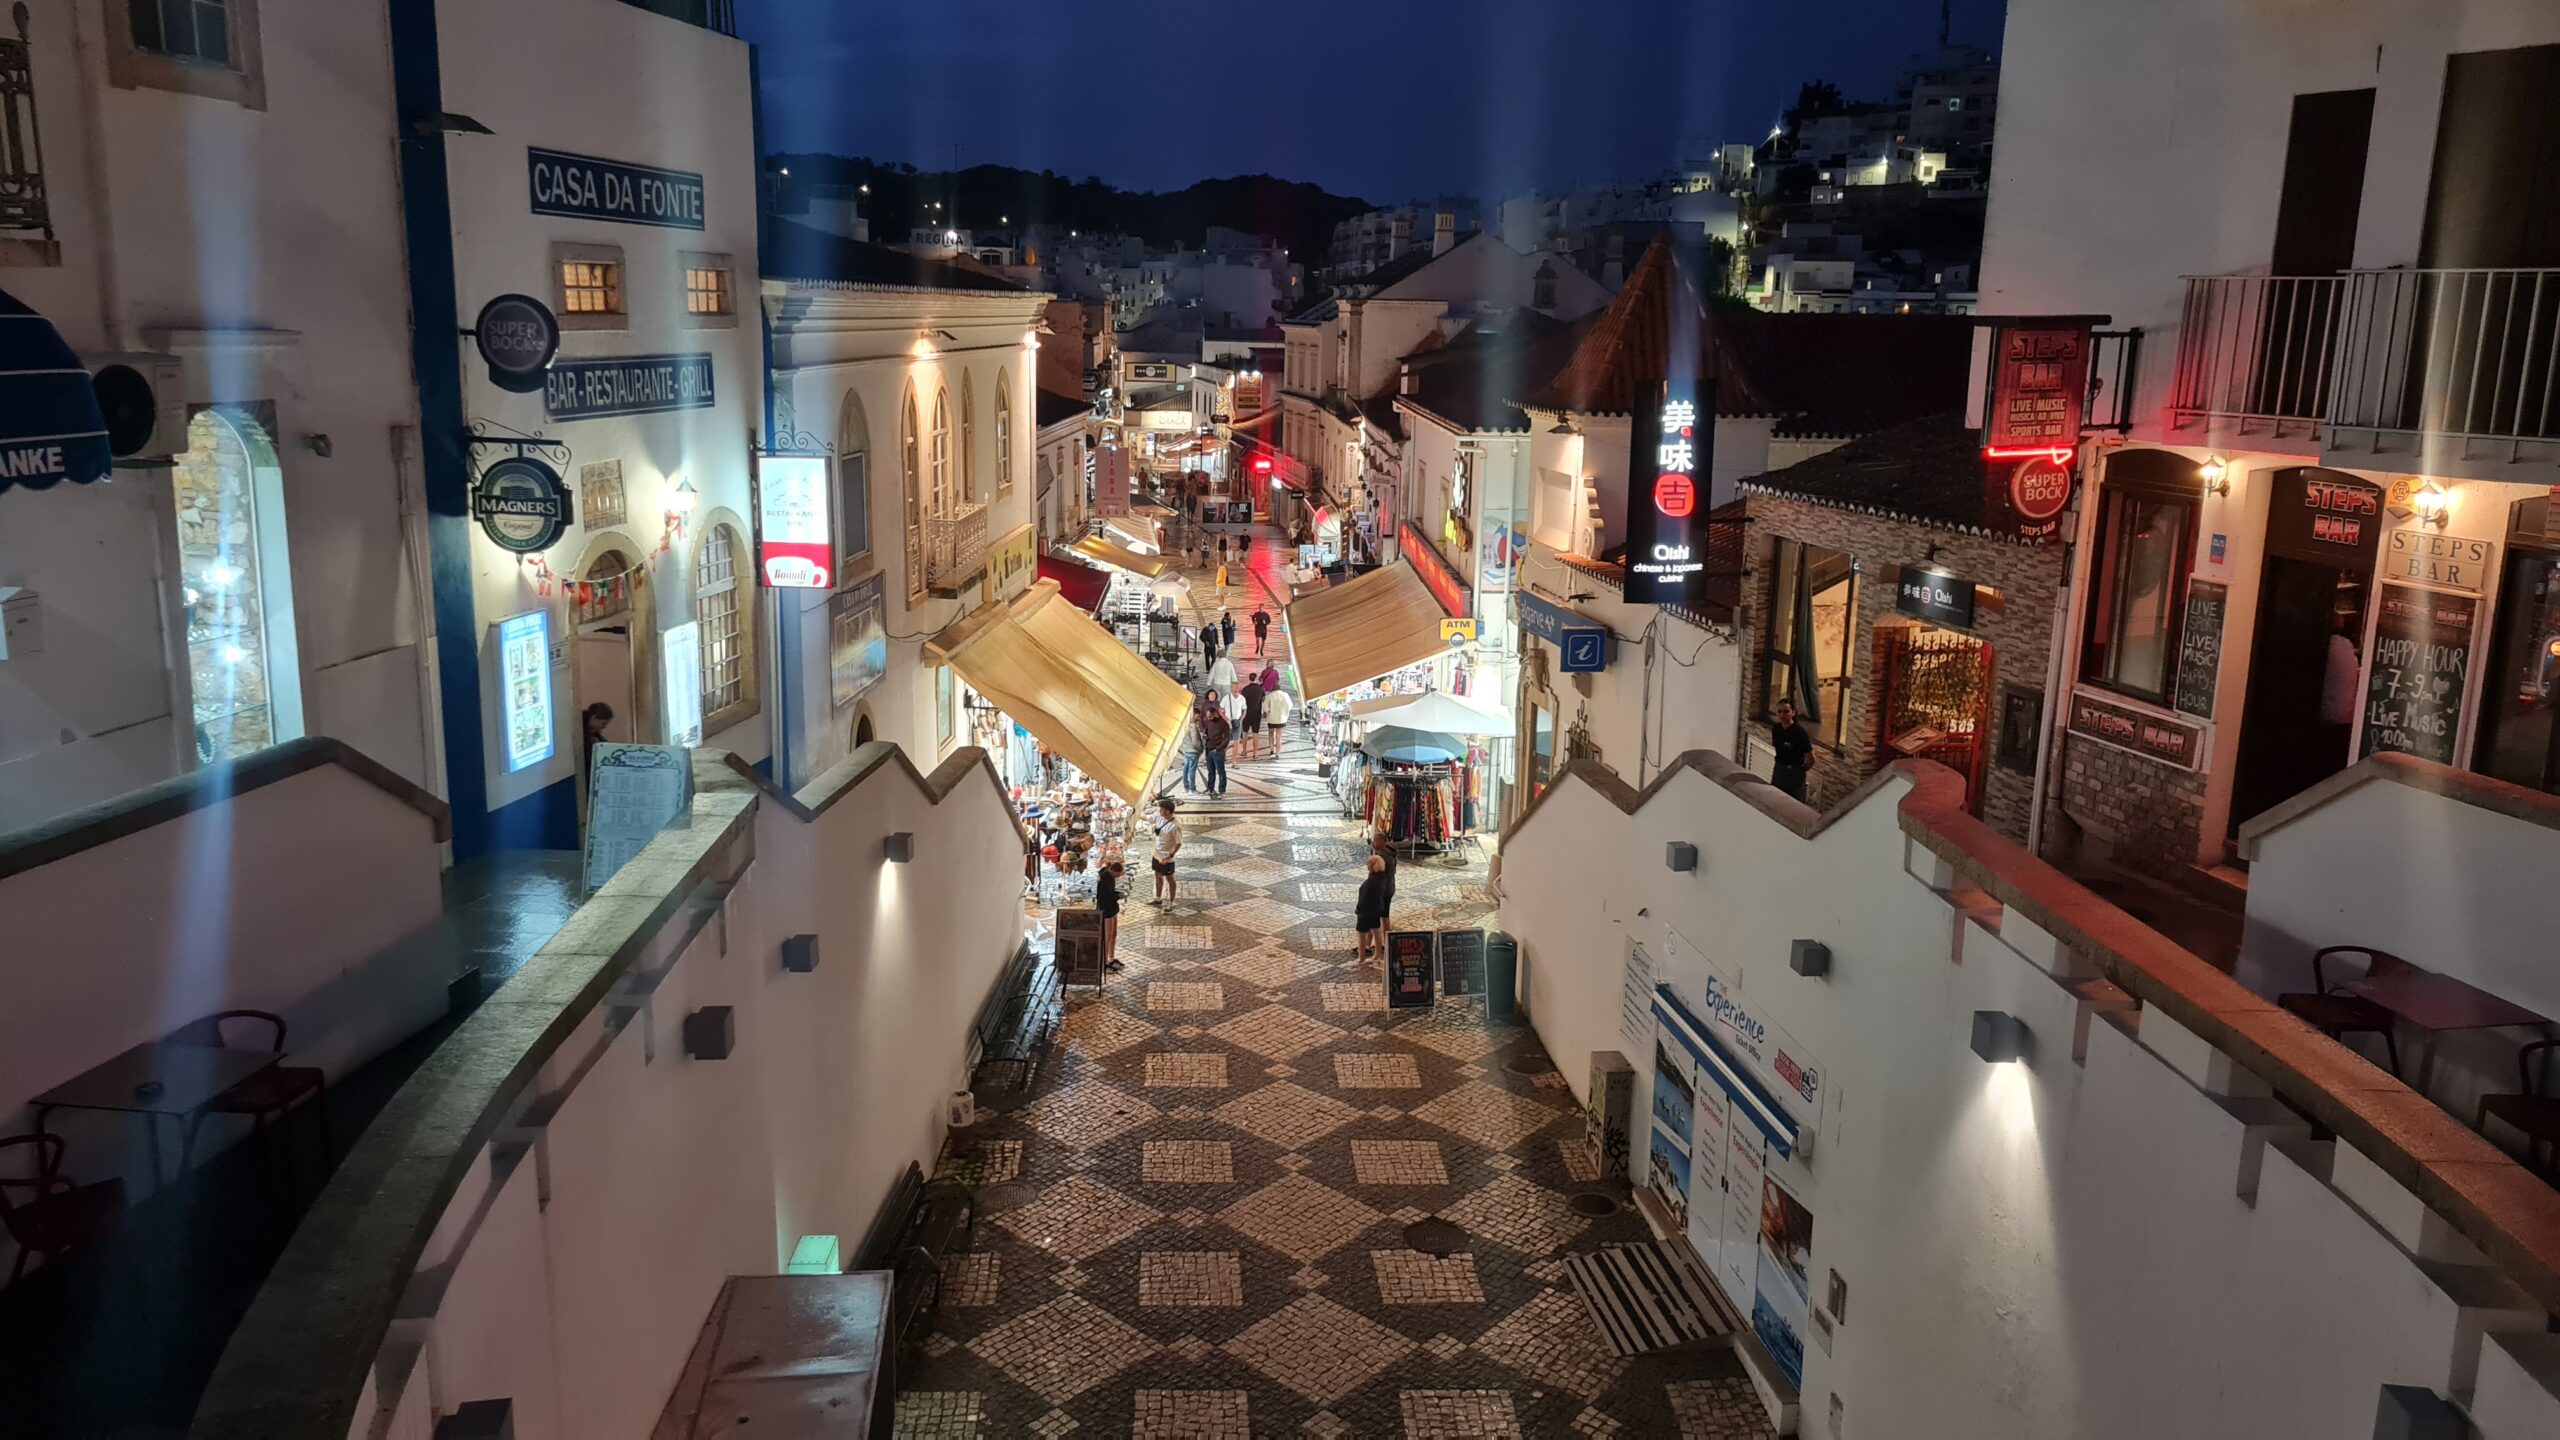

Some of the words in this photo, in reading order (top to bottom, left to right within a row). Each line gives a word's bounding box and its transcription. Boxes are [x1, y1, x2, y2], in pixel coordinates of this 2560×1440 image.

[534, 162, 599, 208] CASA
[604, 173, 635, 212] DA
[640, 178, 702, 220] FONTE
[488, 320, 538, 337] SUPER
[2010, 330, 2079, 359] STEPS
[548, 371, 578, 409] BAR
[587, 367, 675, 406] RESTAURANTE
[679, 365, 712, 398] GRILL
[2020, 363, 2064, 390] BAR
[2011, 400, 2033, 412] LIVE
[2036, 399, 2066, 411] MUSIC
[2009, 425, 2041, 437] SPORTS
[2045, 425, 2062, 435] BAR
[2023, 473, 2065, 488] SUPER
[2025, 486, 2062, 500] BOCK
[481, 498, 556, 515] MAGNERS
[2305, 480, 2379, 516] STEPS
[2020, 524, 2041, 536] STEPS
[2042, 521, 2056, 534] BAR
[2312, 514, 2361, 546] BAR
[1654, 544, 1690, 561] Oishi
[2392, 532, 2485, 562] STEPS
[2407, 558, 2461, 585] BAR
[2435, 607, 2468, 628] BAR
[2376, 636, 2420, 668] HAPPY
[2423, 642, 2465, 681] HOUR
[2179, 688, 2207, 710] HOUR
[2080, 706, 2136, 741] STEPS
[2143, 723, 2186, 756] BAR
[1706, 975, 1765, 1044] Experience
